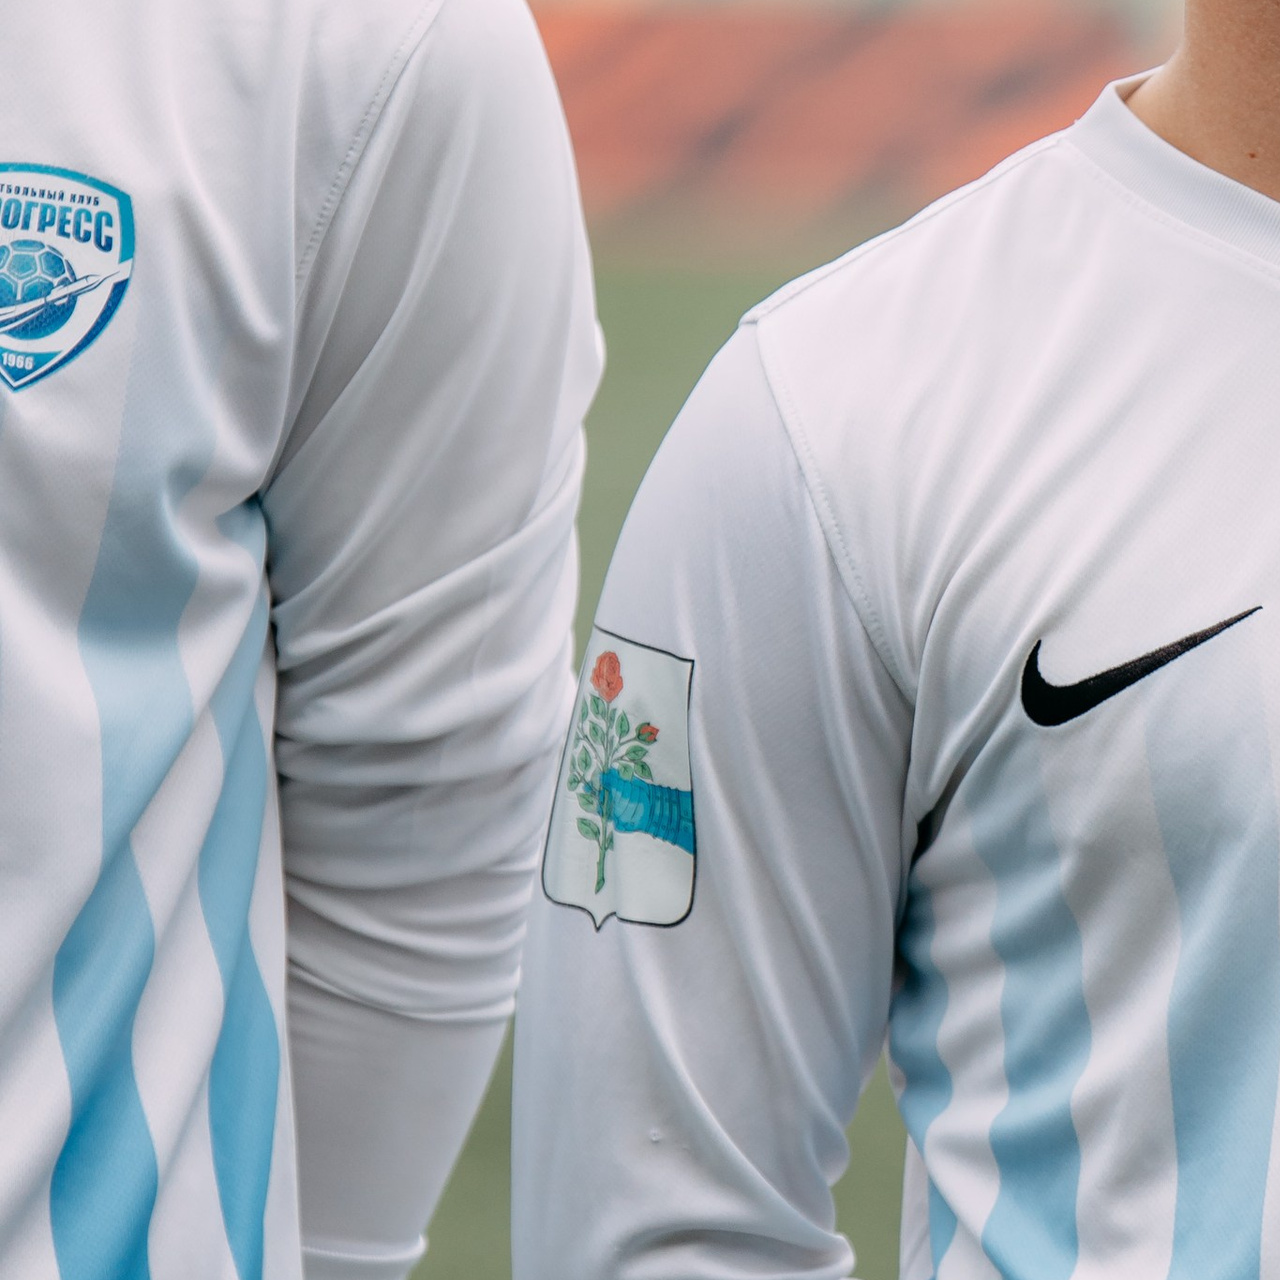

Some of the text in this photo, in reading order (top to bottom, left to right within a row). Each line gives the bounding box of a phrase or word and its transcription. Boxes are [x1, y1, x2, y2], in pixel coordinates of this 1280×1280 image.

[70, 194, 100, 206] КЛУБ
[0, 197, 113, 252] ОГРЕСС
[2, 352, 34, 370] 1966
